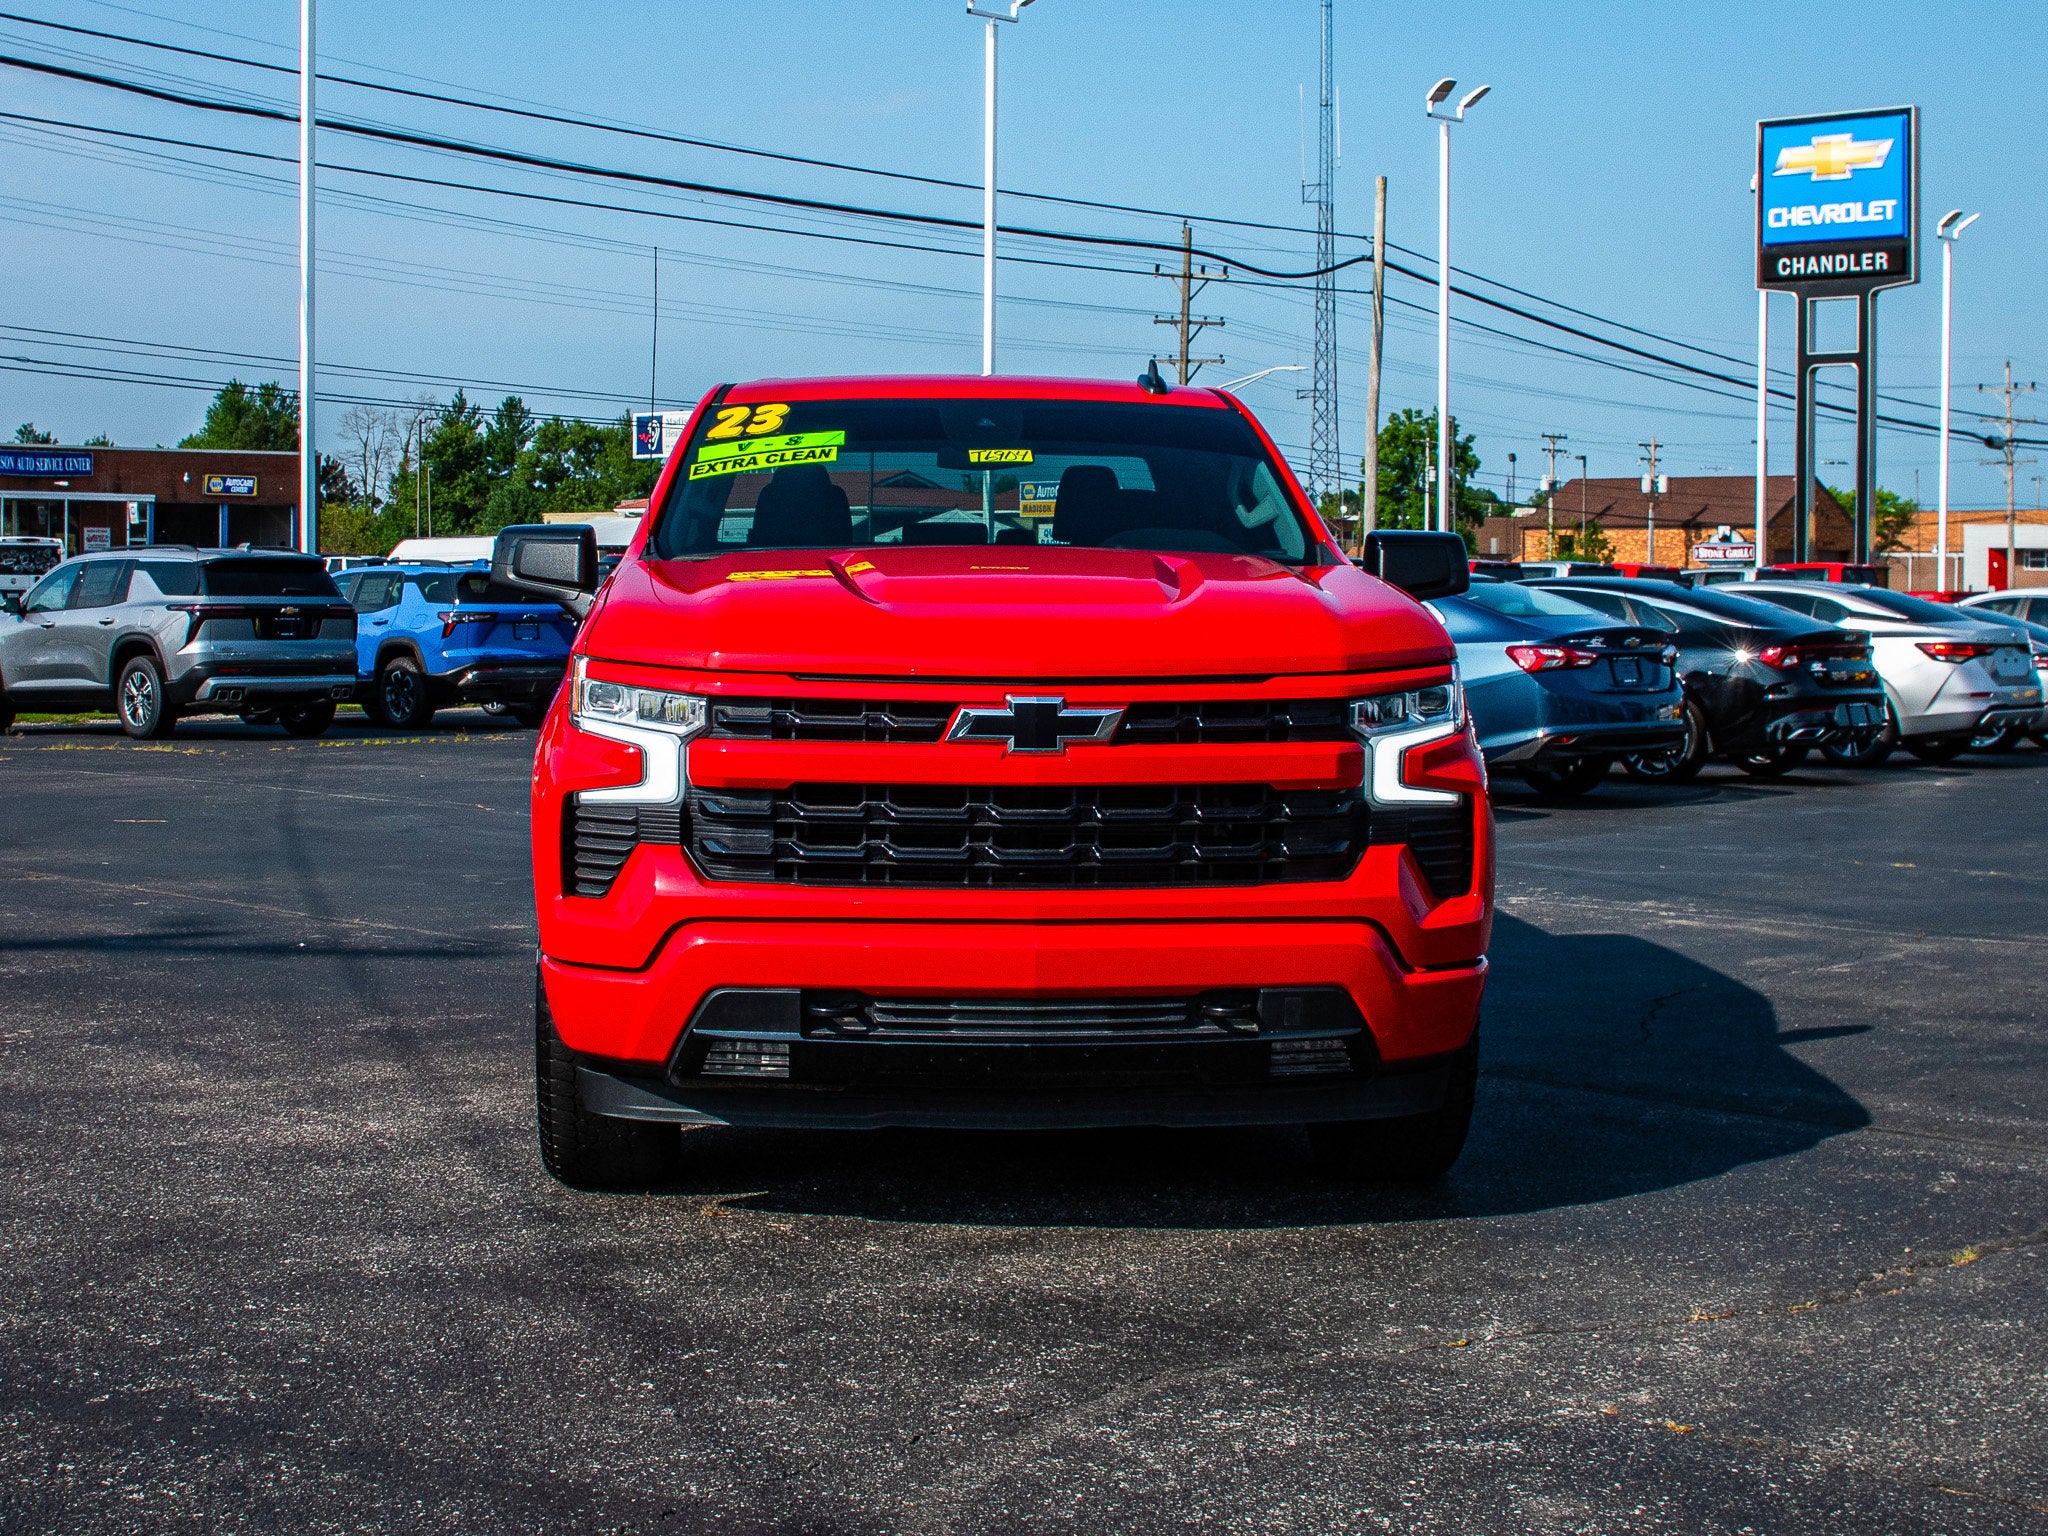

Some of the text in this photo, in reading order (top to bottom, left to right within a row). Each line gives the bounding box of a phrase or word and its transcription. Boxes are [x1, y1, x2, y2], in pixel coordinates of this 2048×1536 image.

[1768, 199, 1898, 228] CHEVROLET
[1777, 251, 1888, 275] CHANDLER
[706, 403, 791, 440] 23
[17, 457, 35, 471] AUTO
[36, 457, 63, 471] SERVICE
[65, 457, 91, 471] CENTER
[692, 448, 834, 477] EXTRA CLEAN
[1022, 503, 1052, 513] MADISON
[1698, 547, 1749, 558] STONE GRILL
